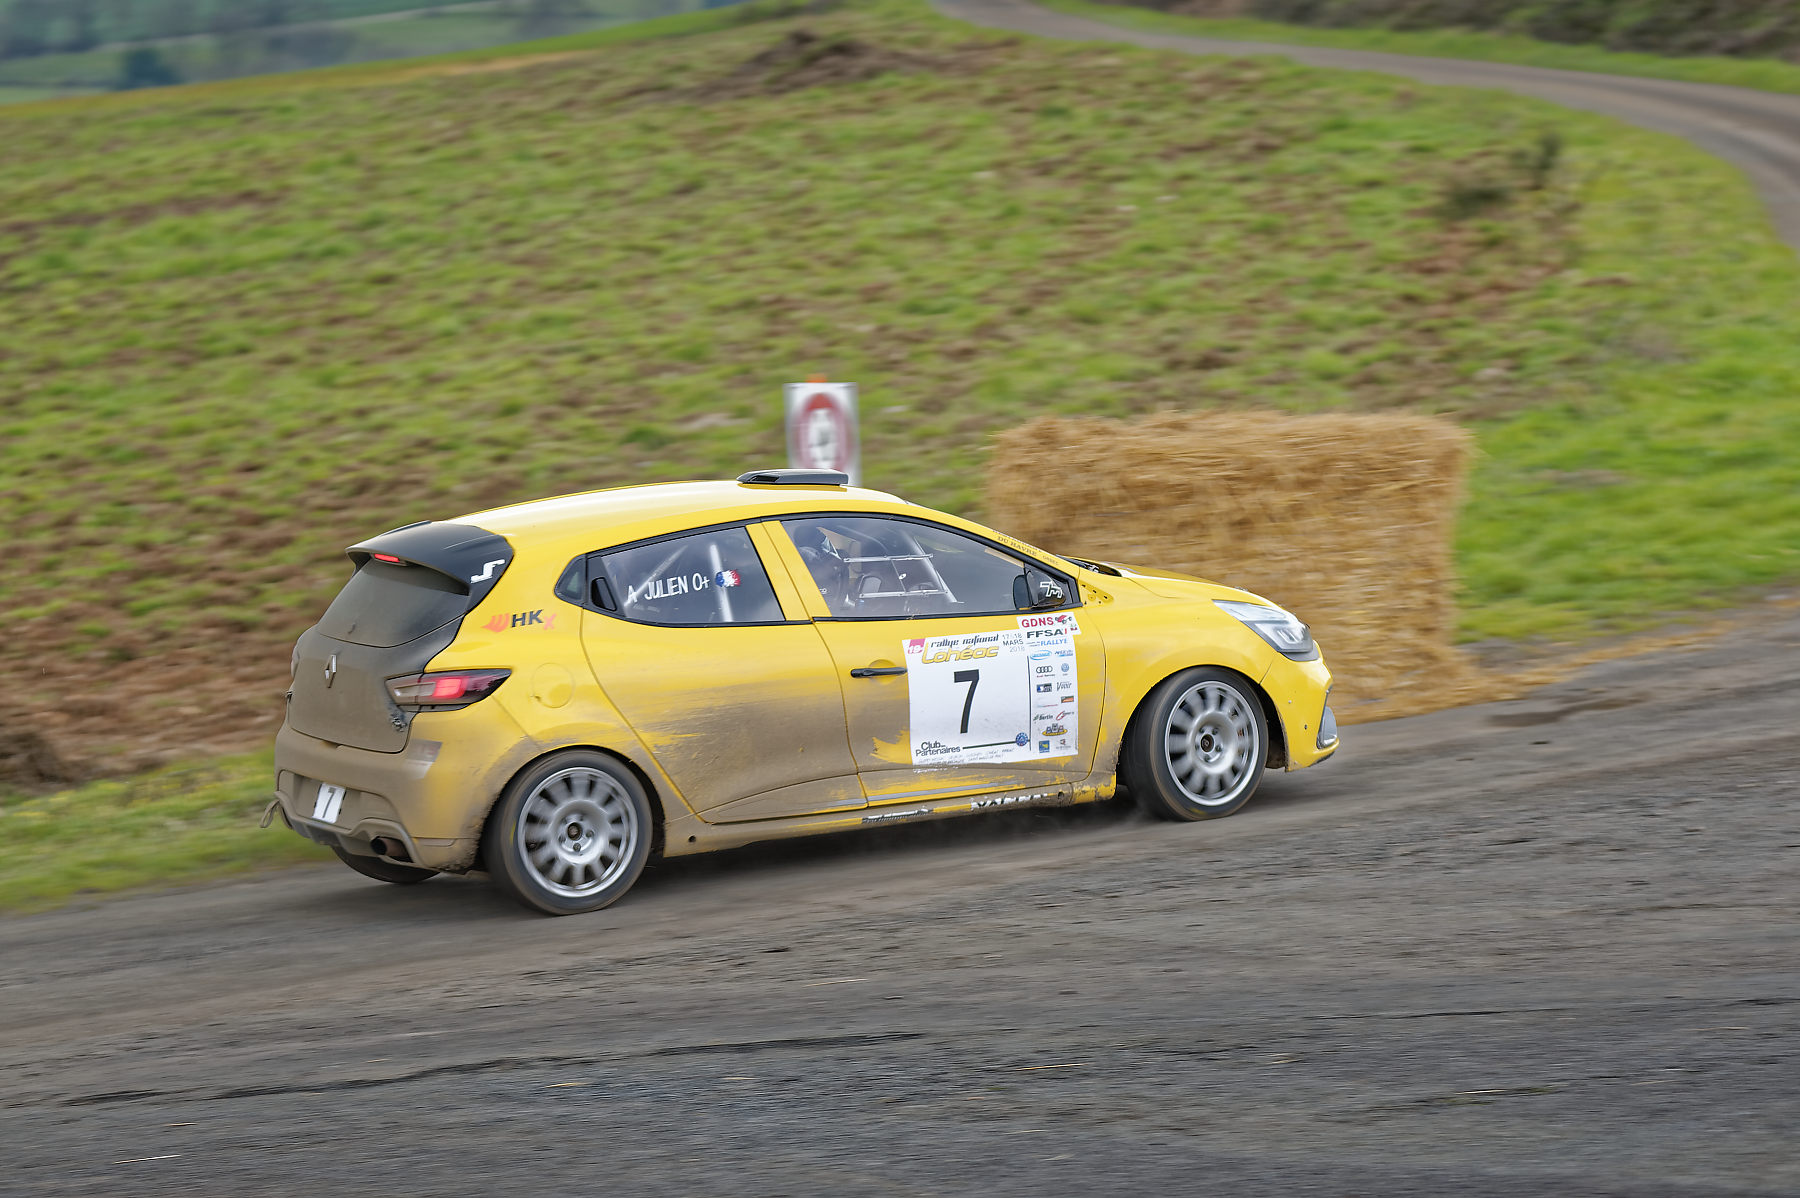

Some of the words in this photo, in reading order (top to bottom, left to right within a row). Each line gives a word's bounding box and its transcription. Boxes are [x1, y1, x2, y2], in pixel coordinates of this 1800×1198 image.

[1021, 617, 1054, 628] GDNS
[1027, 629, 1064, 638] FFSA
[931, 639, 959, 648] rallye
[963, 634, 999, 645] national
[922, 642, 999, 664] Lohéac
[954, 669, 979, 734] 7
[915, 746, 961, 757] Partenaires
[921, 741, 941, 751] Club
[323, 787, 336, 818] 7
